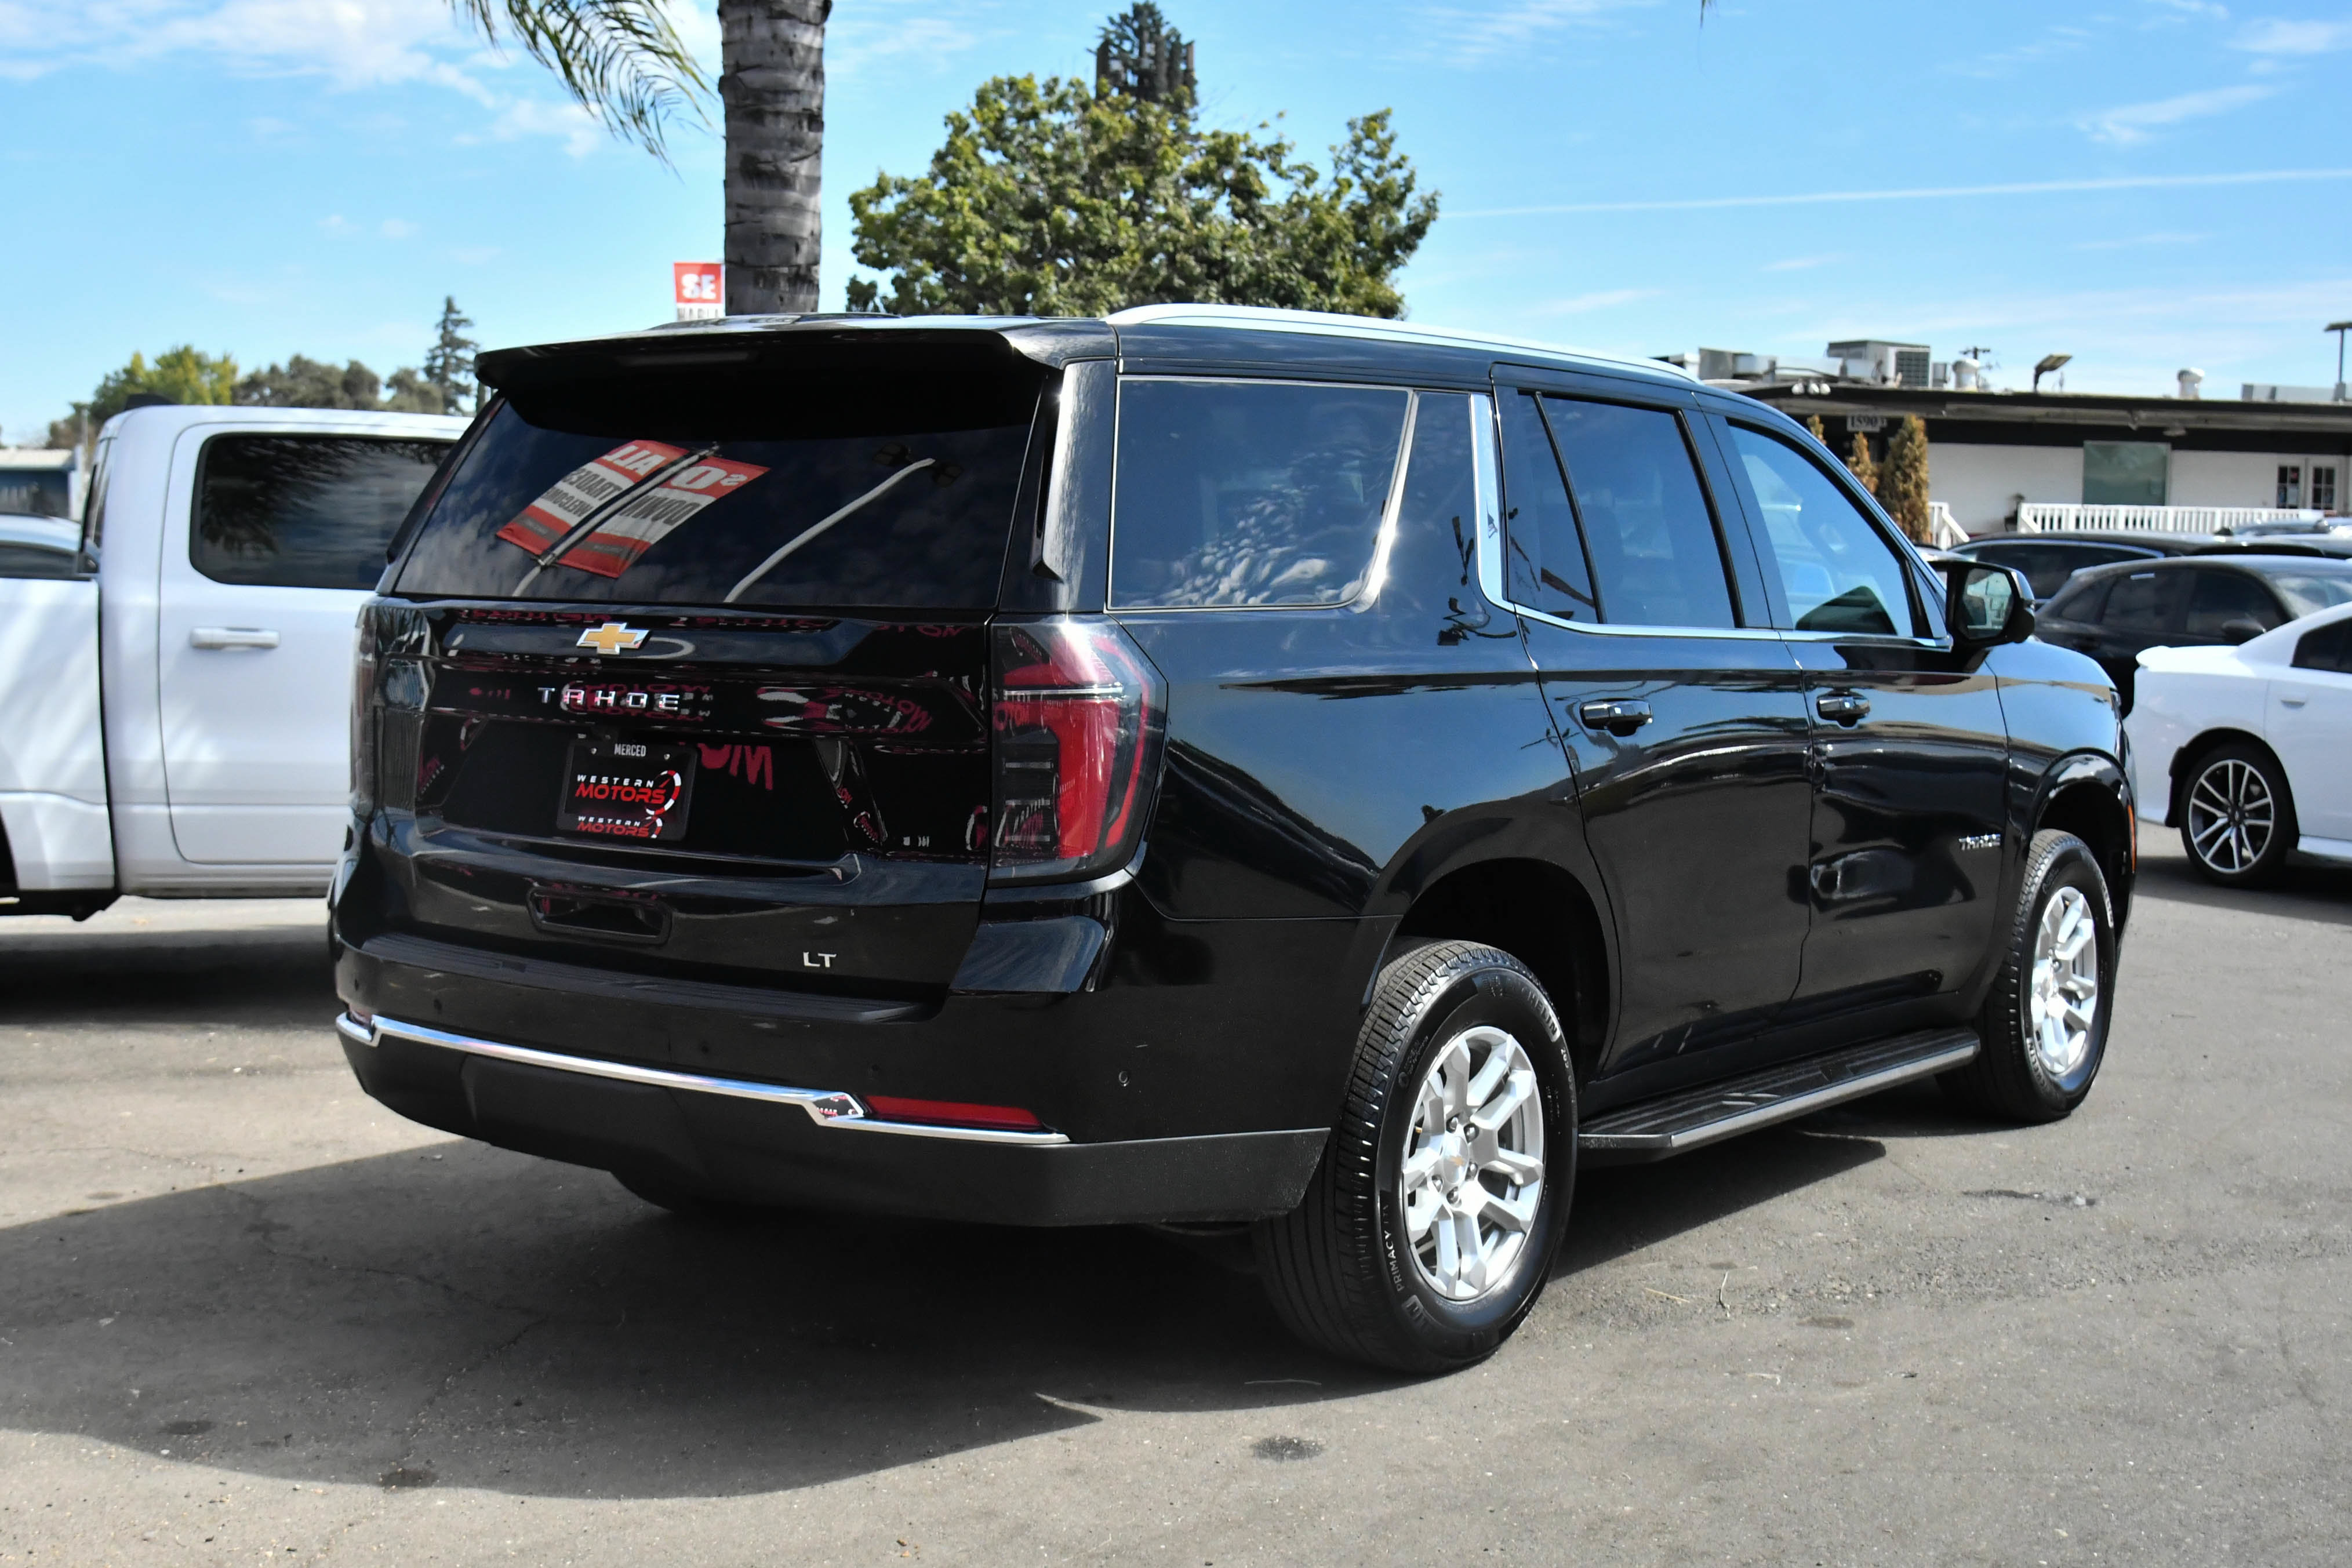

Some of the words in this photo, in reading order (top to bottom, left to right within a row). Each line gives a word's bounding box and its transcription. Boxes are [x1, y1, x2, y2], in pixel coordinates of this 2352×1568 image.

[537, 687, 680, 711] TAHOE
[614, 743, 646, 758] MERCED
[577, 774, 654, 787] WESTERN
[575, 783, 666, 804] MOTORS
[577, 816, 641, 827] WESTERN
[577, 821, 650, 838] MOTORS
[803, 952, 837, 968] LT
[1384, 1230, 1405, 1292] PRIMACY
